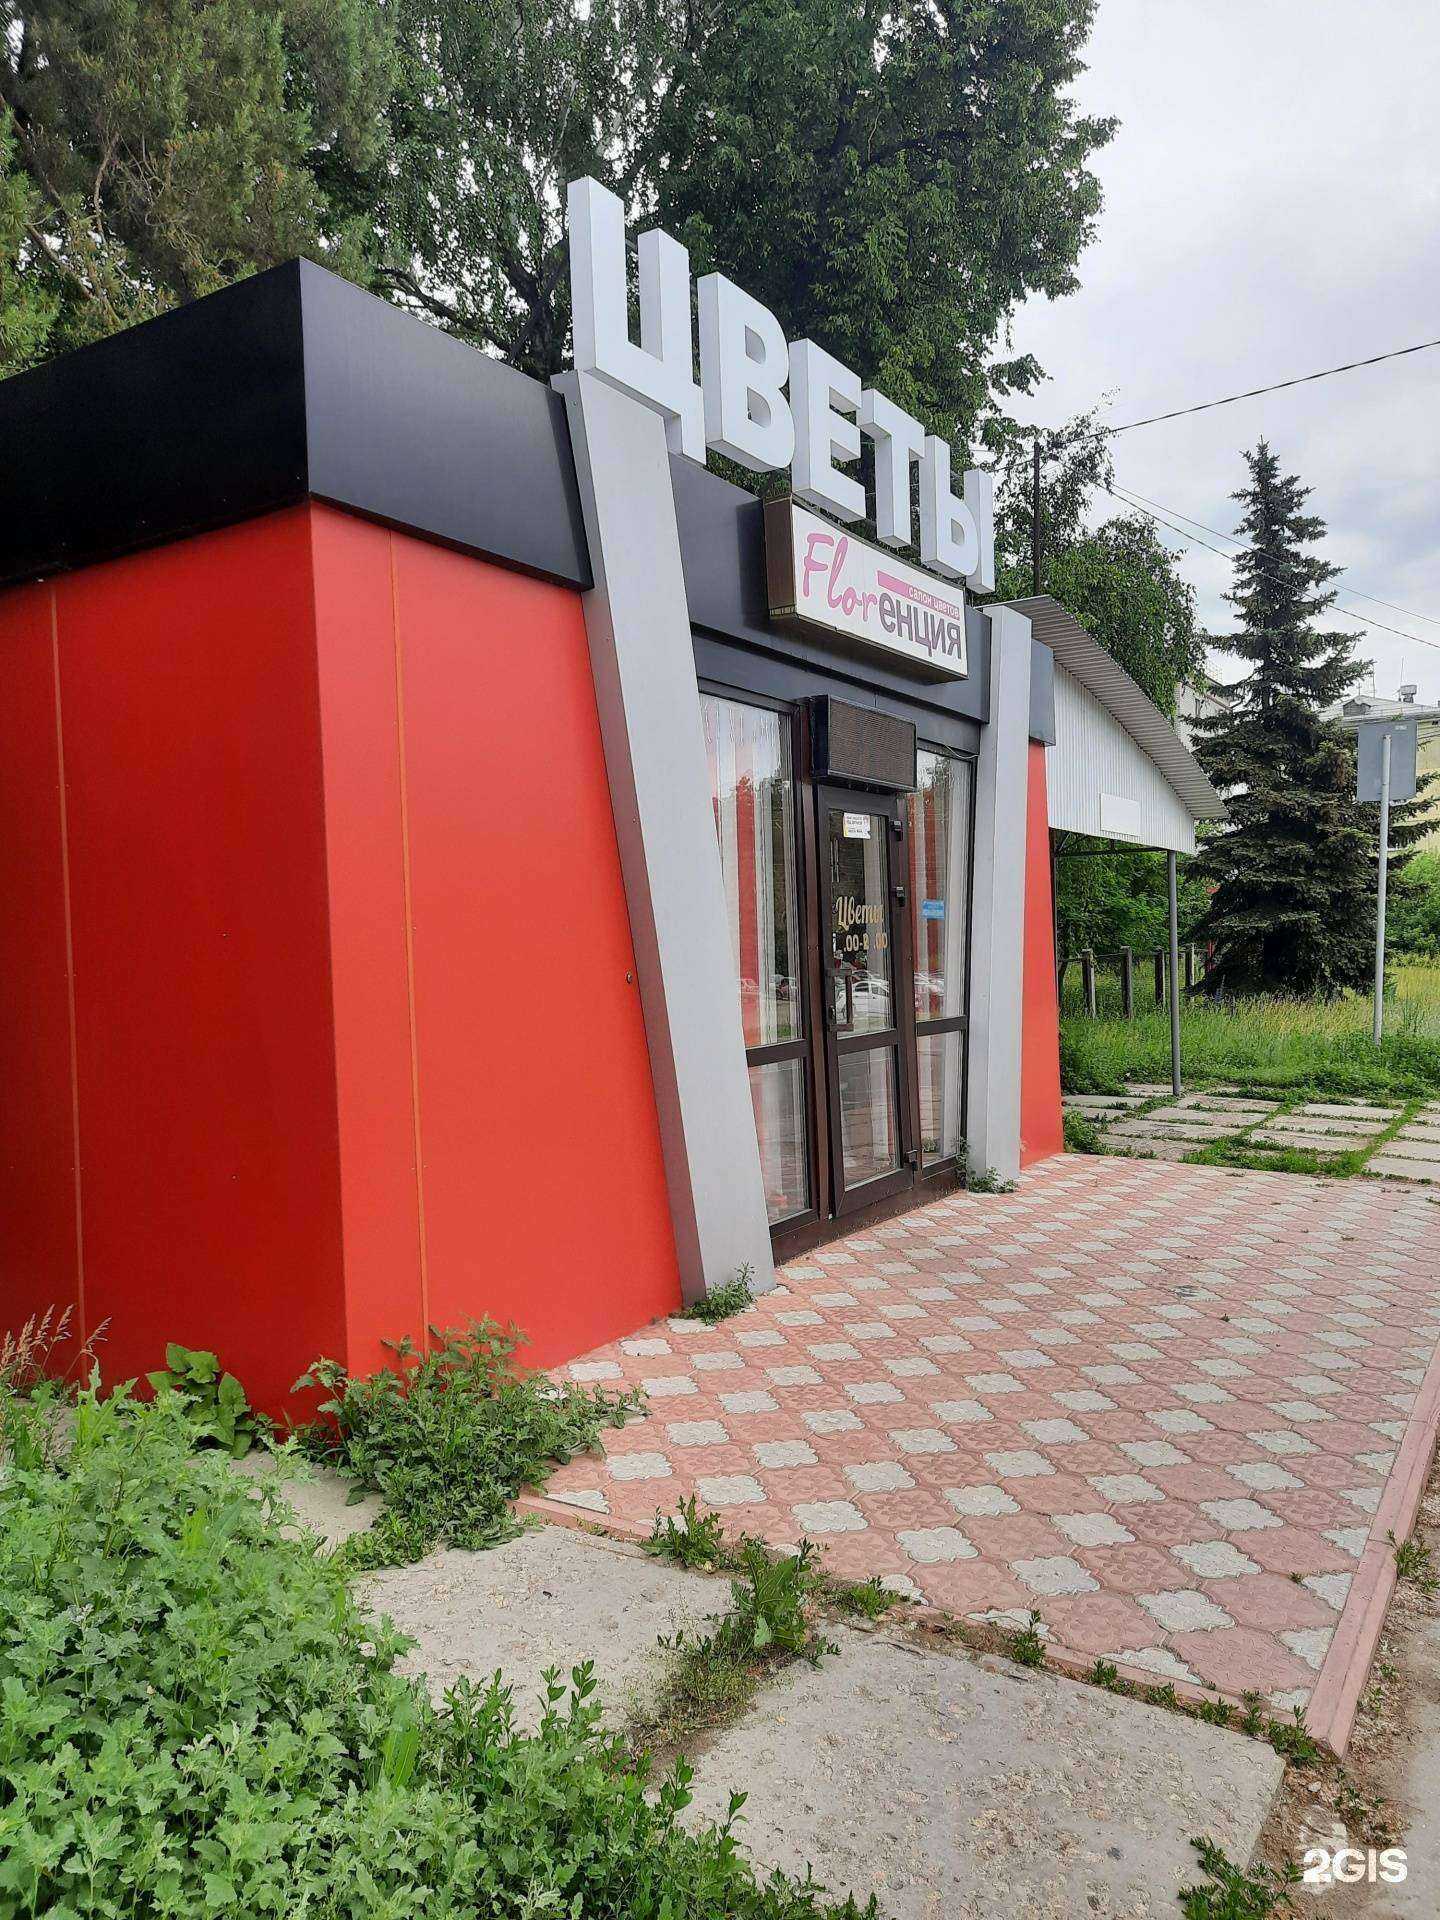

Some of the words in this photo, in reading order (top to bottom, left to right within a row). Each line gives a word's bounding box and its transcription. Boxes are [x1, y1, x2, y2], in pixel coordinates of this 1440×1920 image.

[567, 175, 993, 595] ЦВЕТЫ
[908, 586, 932, 607] салон
[933, 597, 961, 619] цветов
